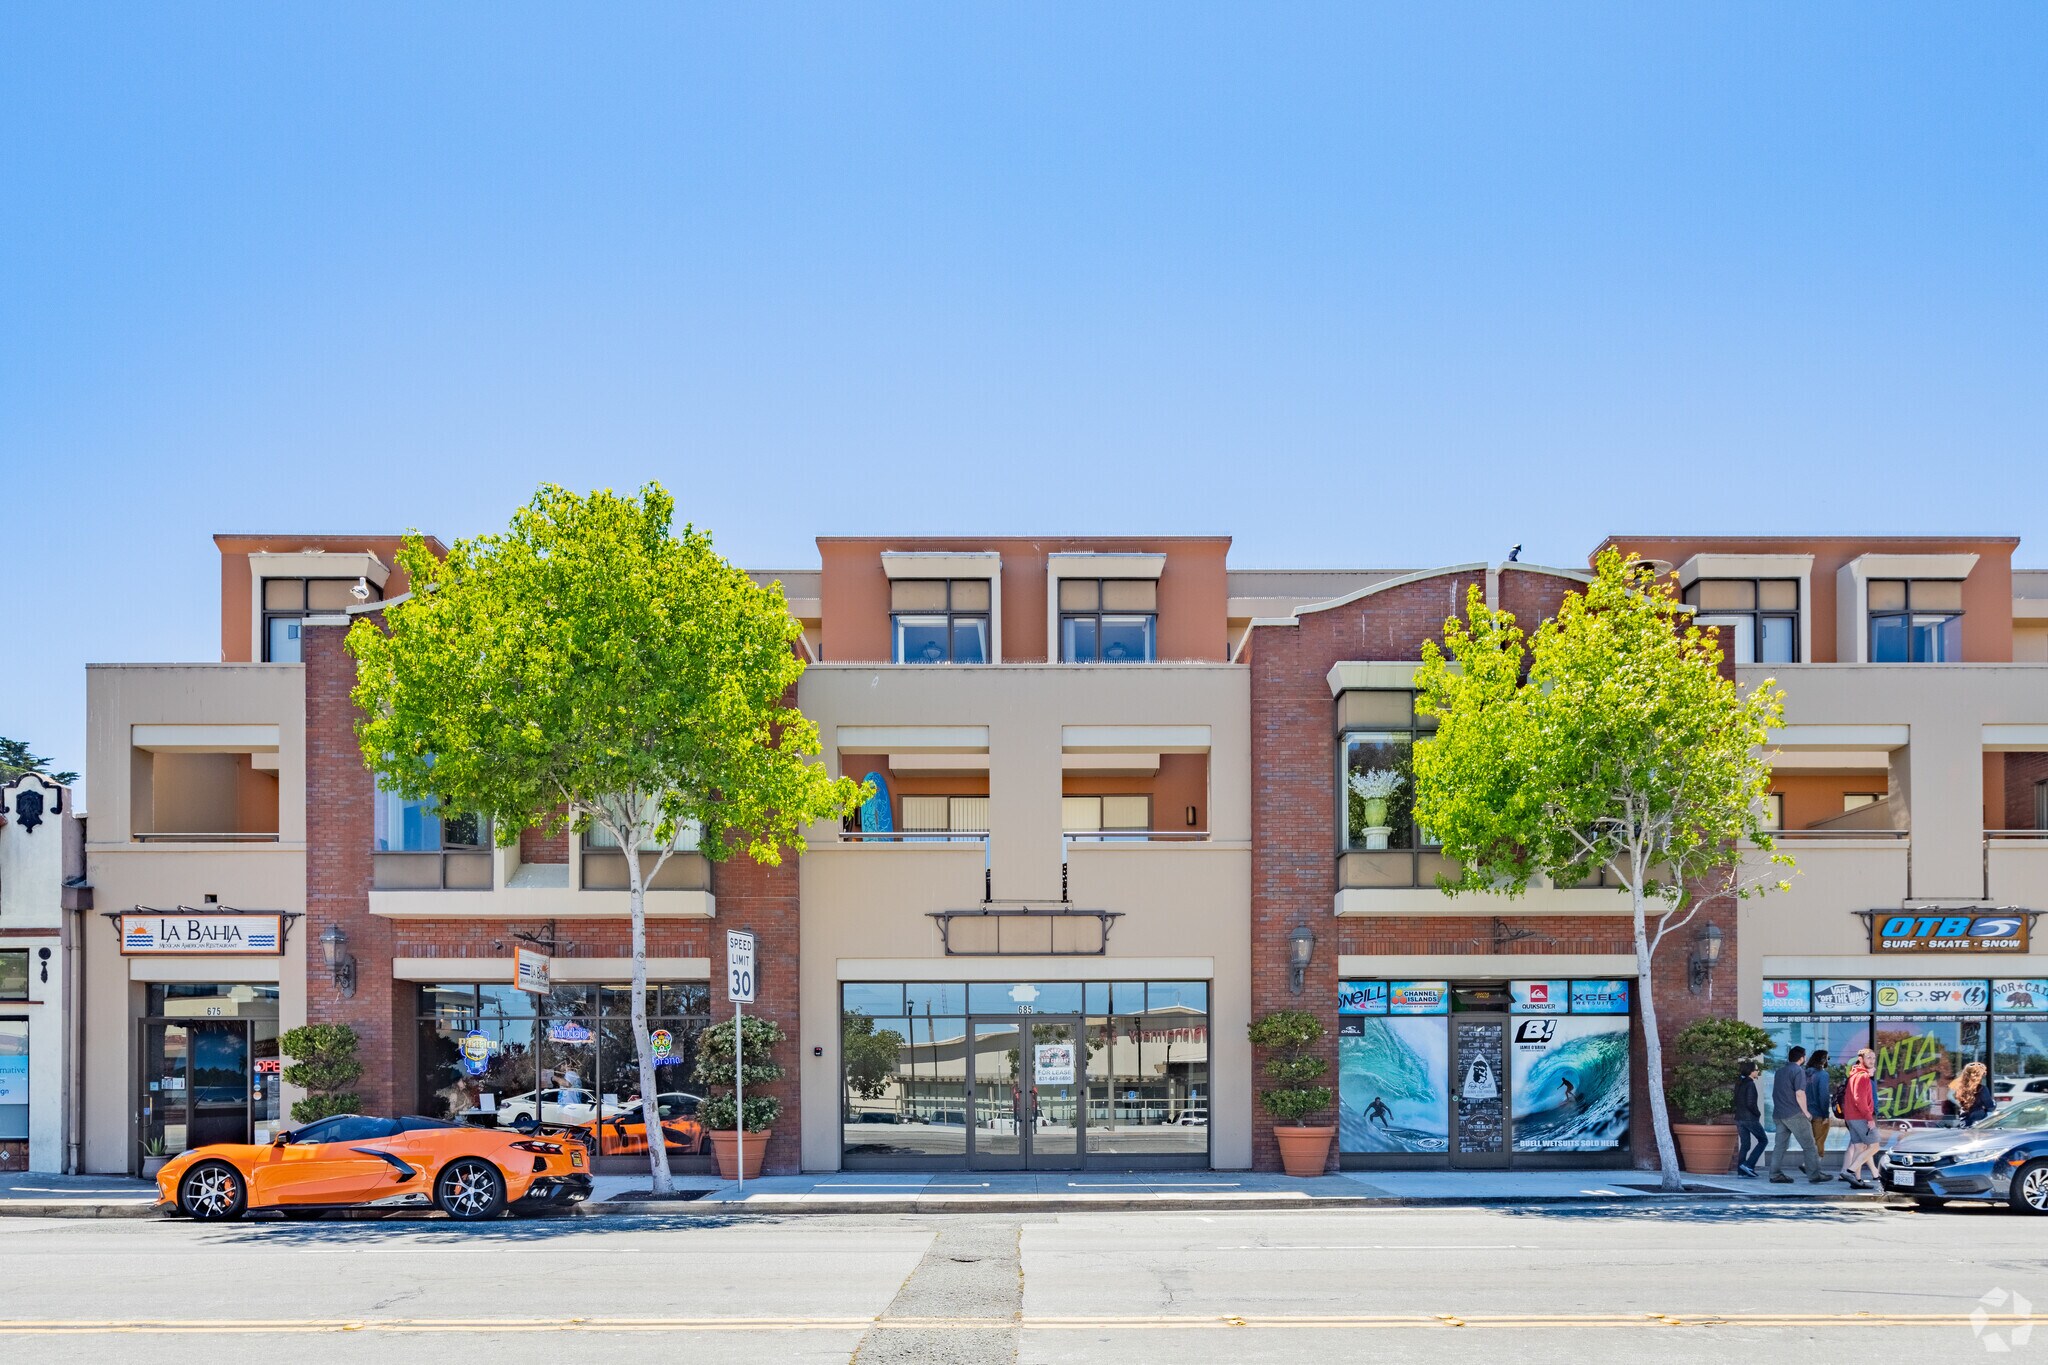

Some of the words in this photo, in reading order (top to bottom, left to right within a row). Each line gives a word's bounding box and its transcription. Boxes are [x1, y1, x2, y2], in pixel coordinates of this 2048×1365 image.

[1881, 917, 1971, 937] OTB
[730, 937, 751, 951] SPEED
[1882, 940, 1917, 948] SURF
[1928, 940, 1970, 948] SKATE
[1981, 939, 2020, 948] SNOW
[732, 953, 749, 966] LIMIT
[732, 969, 751, 996] 30
[1830, 985, 1850, 994] VANS
[1930, 990, 1951, 1002] SPY
[1993, 983, 2015, 997] NOR
[207, 1007, 221, 1016] 675
[1018, 1005, 1032, 1014] 685
[554, 1026, 589, 1040] Modelo
[257, 1060, 280, 1072] OPE
[1877, 1072, 1937, 1119] RUZ
